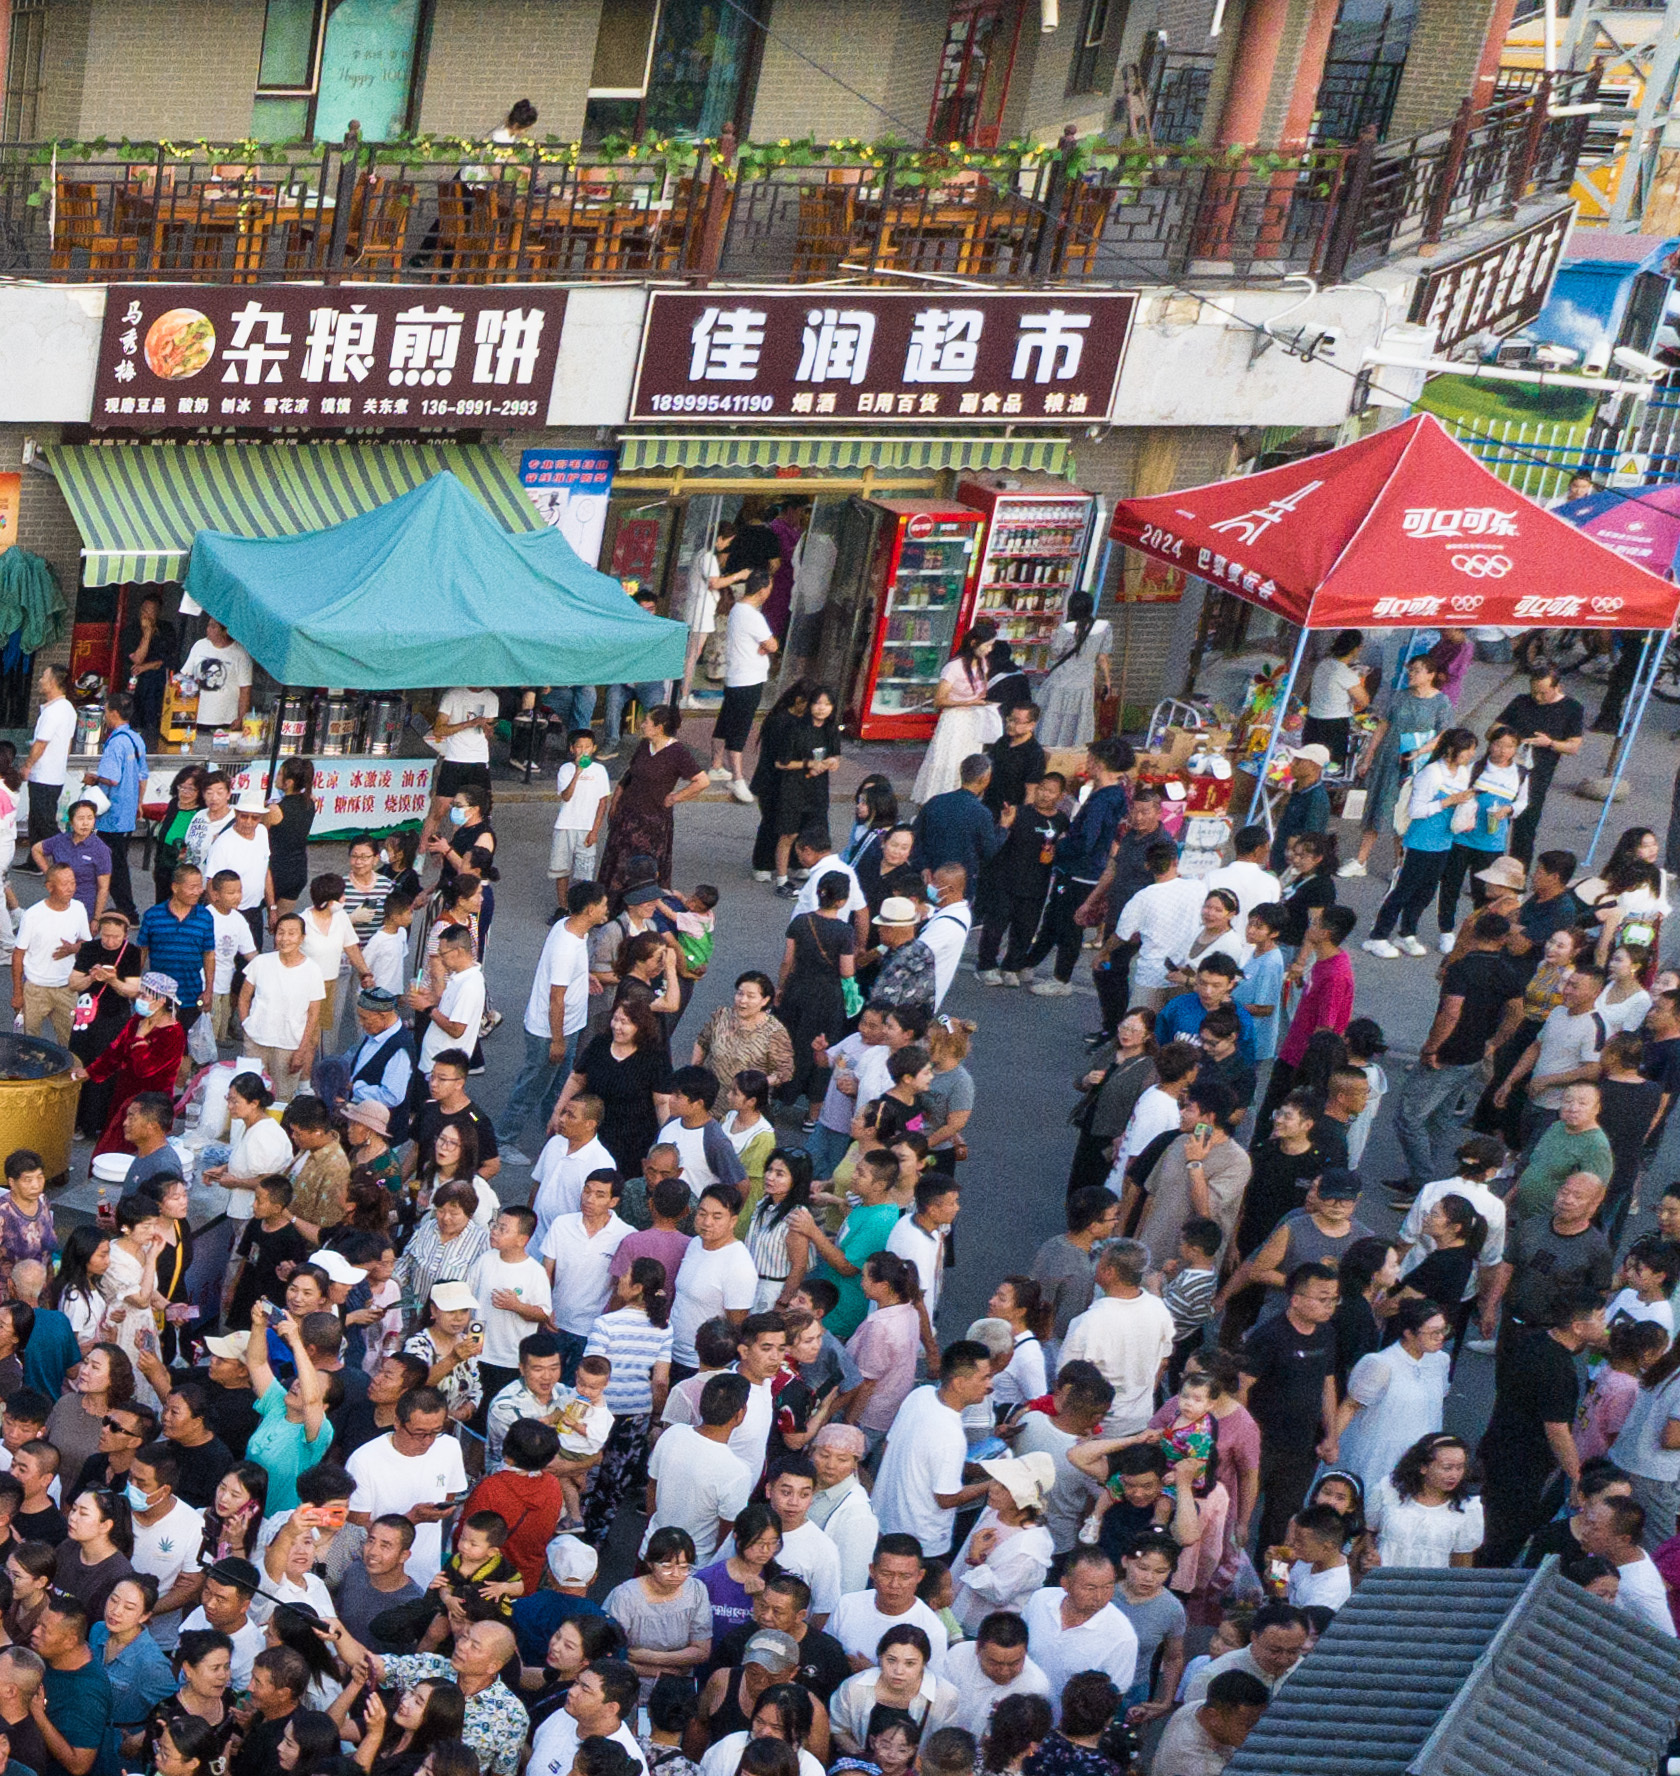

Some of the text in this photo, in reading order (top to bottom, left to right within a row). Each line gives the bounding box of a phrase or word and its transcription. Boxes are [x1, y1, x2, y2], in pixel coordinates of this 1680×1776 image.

[113, 300, 144, 384] 马秀梅
[221, 300, 547, 387] 杂粮煎饼
[689, 307, 1093, 385] 佳润超市
[177, 397, 209, 414] 酸奶
[220, 397, 252, 414] 刨冰
[263, 397, 310, 414] 雪花凉
[362, 397, 409, 414] 关东煮
[421, 399, 539, 416] 136-8991-2993
[650, 392, 1089, 413] 18999541190 烟酒 日用百货 副食品 粮油
[1401, 507, 1520, 538] 可口可乐
[1139, 523, 1277, 601] 2024 巴黎奥运会
[1372, 595, 1447, 618] 可口可乐
[1512, 595, 1588, 618] 可口可乐
[349, 769, 393, 789] 冰激凌
[402, 768, 431, 788] 油香
